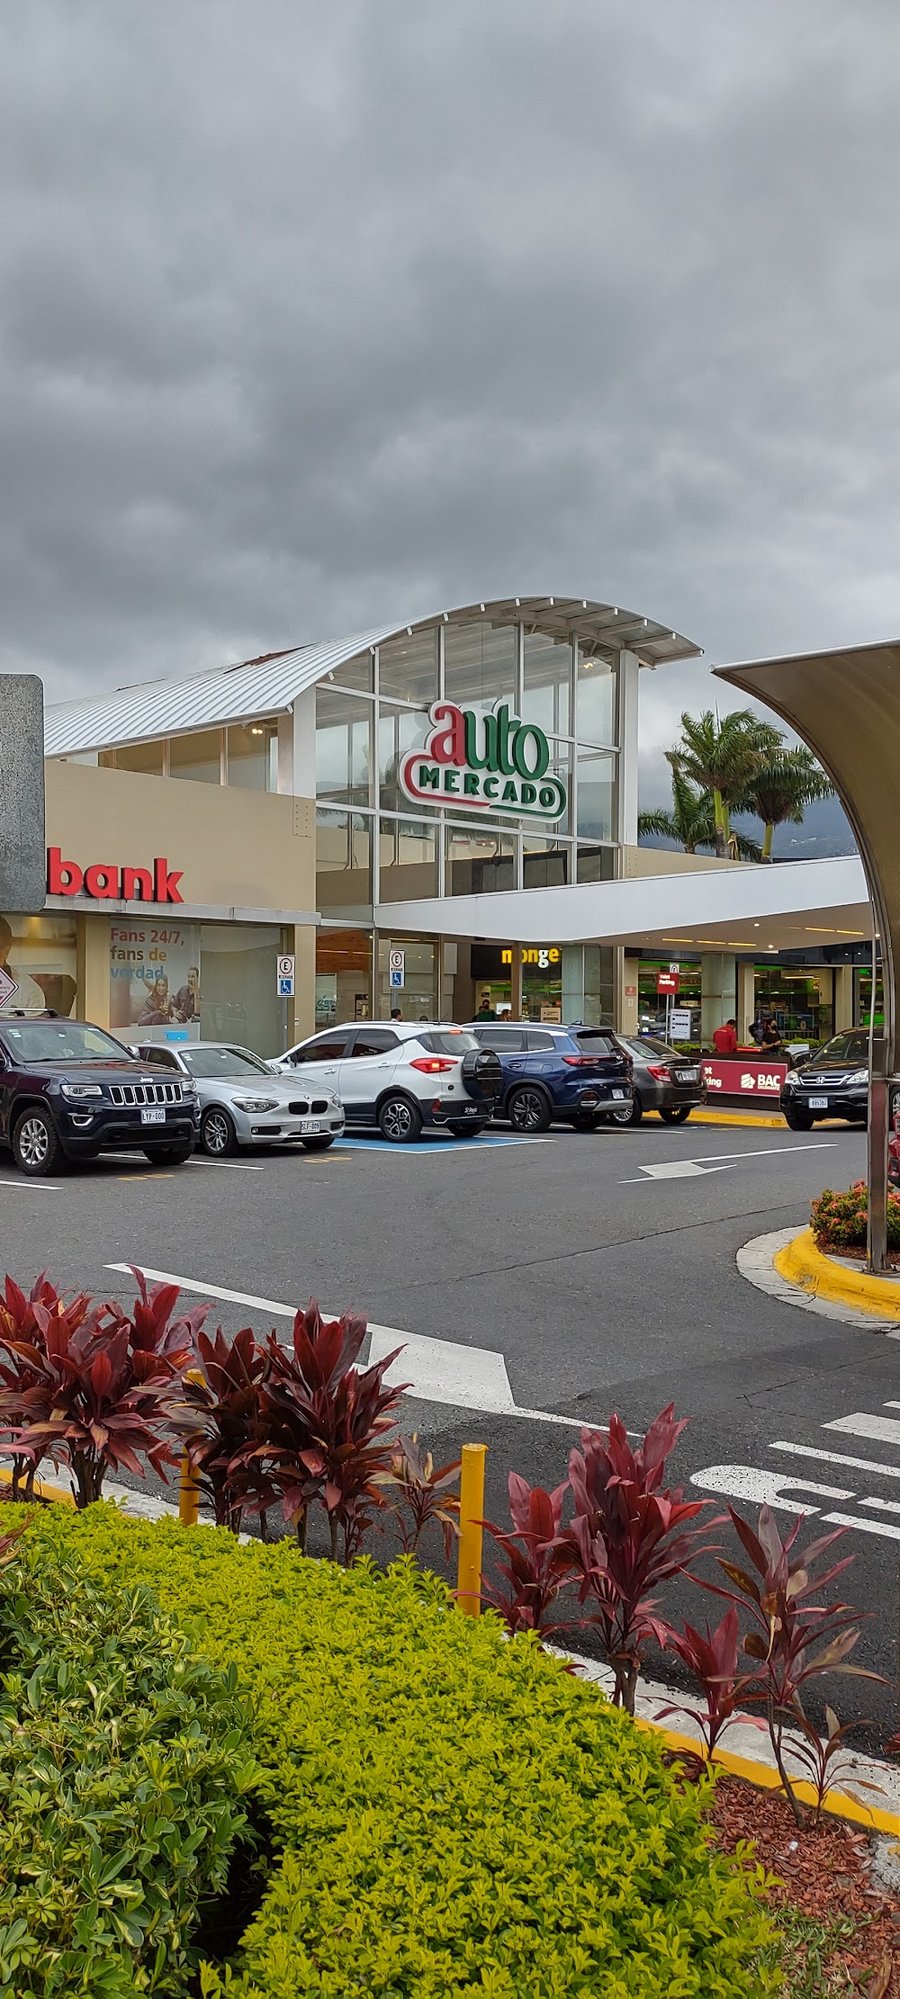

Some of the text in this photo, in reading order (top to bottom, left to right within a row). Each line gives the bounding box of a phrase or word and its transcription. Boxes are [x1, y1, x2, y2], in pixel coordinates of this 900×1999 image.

[431, 704, 550, 781] auto
[419, 765, 556, 808] MERCADO
[47, 847, 185, 903] bank
[110, 927, 184, 946] Fans 24/7,
[110, 945, 167, 961] fans de
[110, 965, 164, 980] verdad
[757, 1074, 781, 1087] BAC
